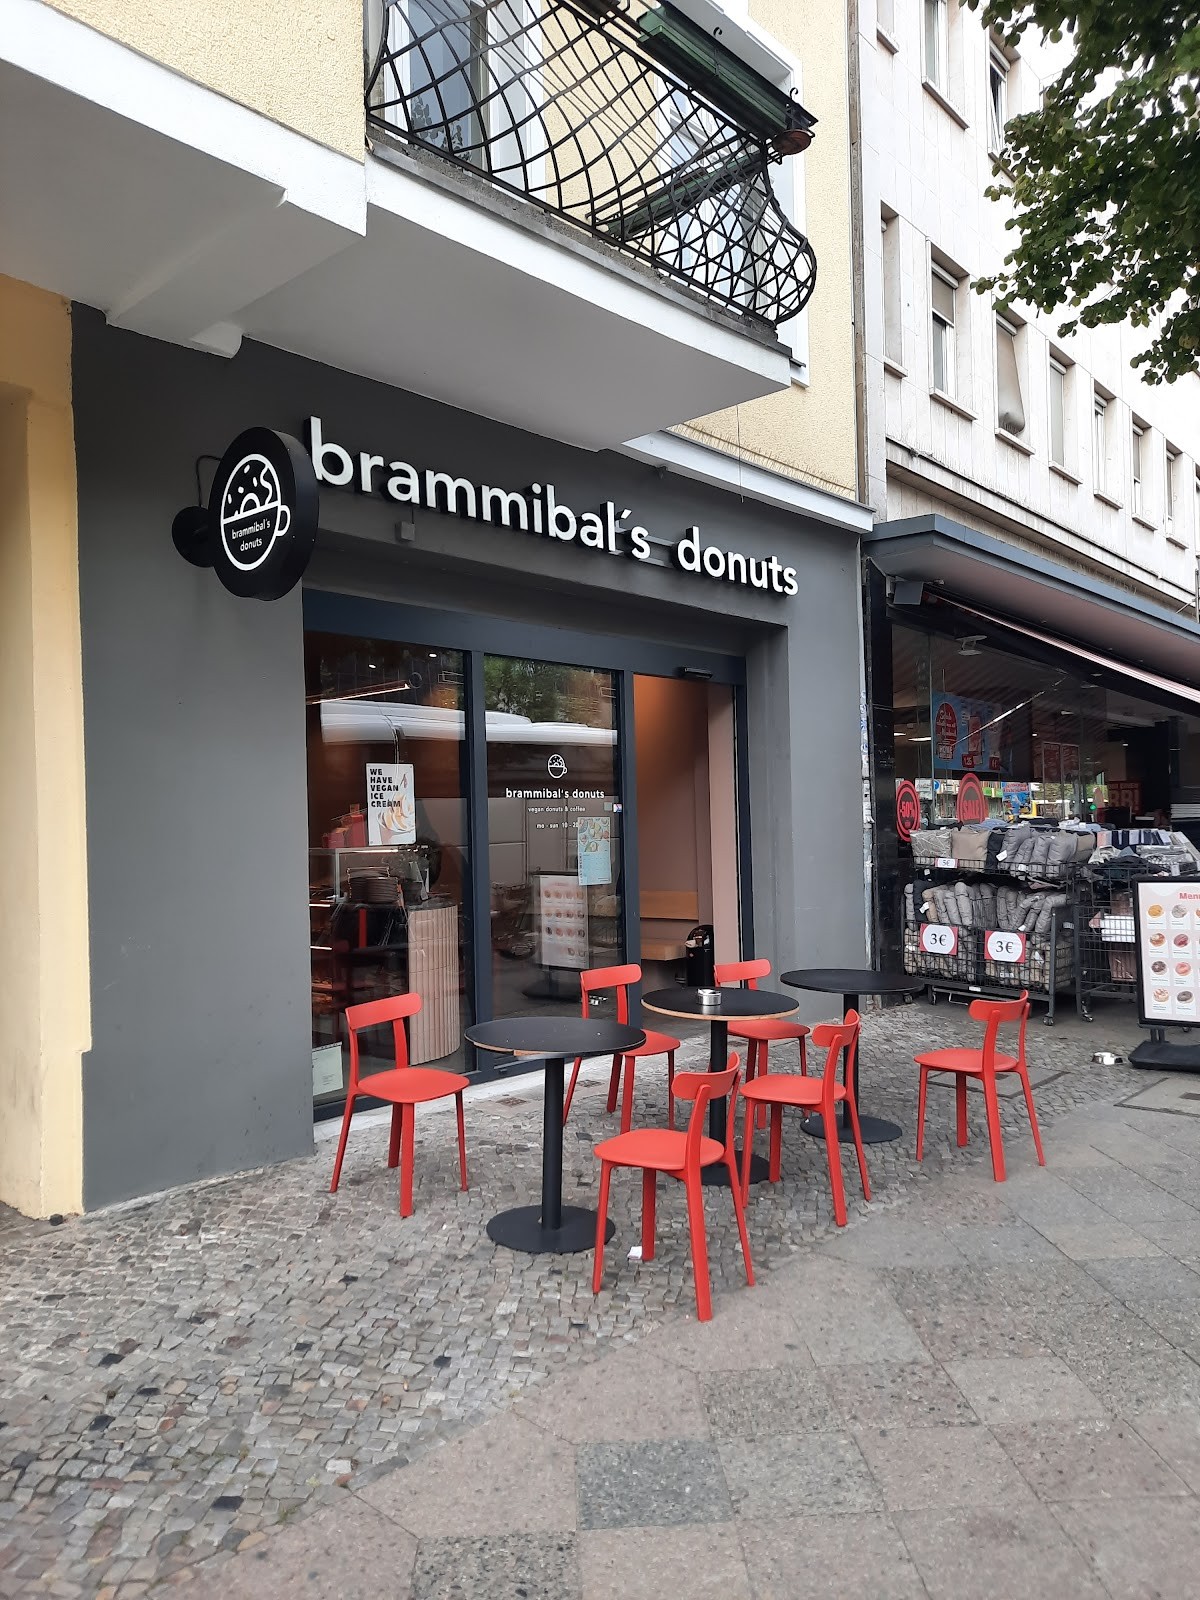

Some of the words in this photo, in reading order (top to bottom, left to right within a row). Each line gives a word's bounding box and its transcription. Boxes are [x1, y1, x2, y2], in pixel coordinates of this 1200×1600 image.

[240, 537, 263, 552] donuts
[677, 525, 799, 596] donuts
[369, 768, 383, 776] WE
[370, 776, 393, 784] HAVE
[370, 784, 399, 792] VEGAN
[370, 792, 384, 800] ICE
[572, 788, 605, 799] donuts
[370, 800, 401, 808] CREAM
[527, 806, 545, 814] vegan
[929, 933, 947, 947] 3€
[995, 940, 1014, 954] 3€
